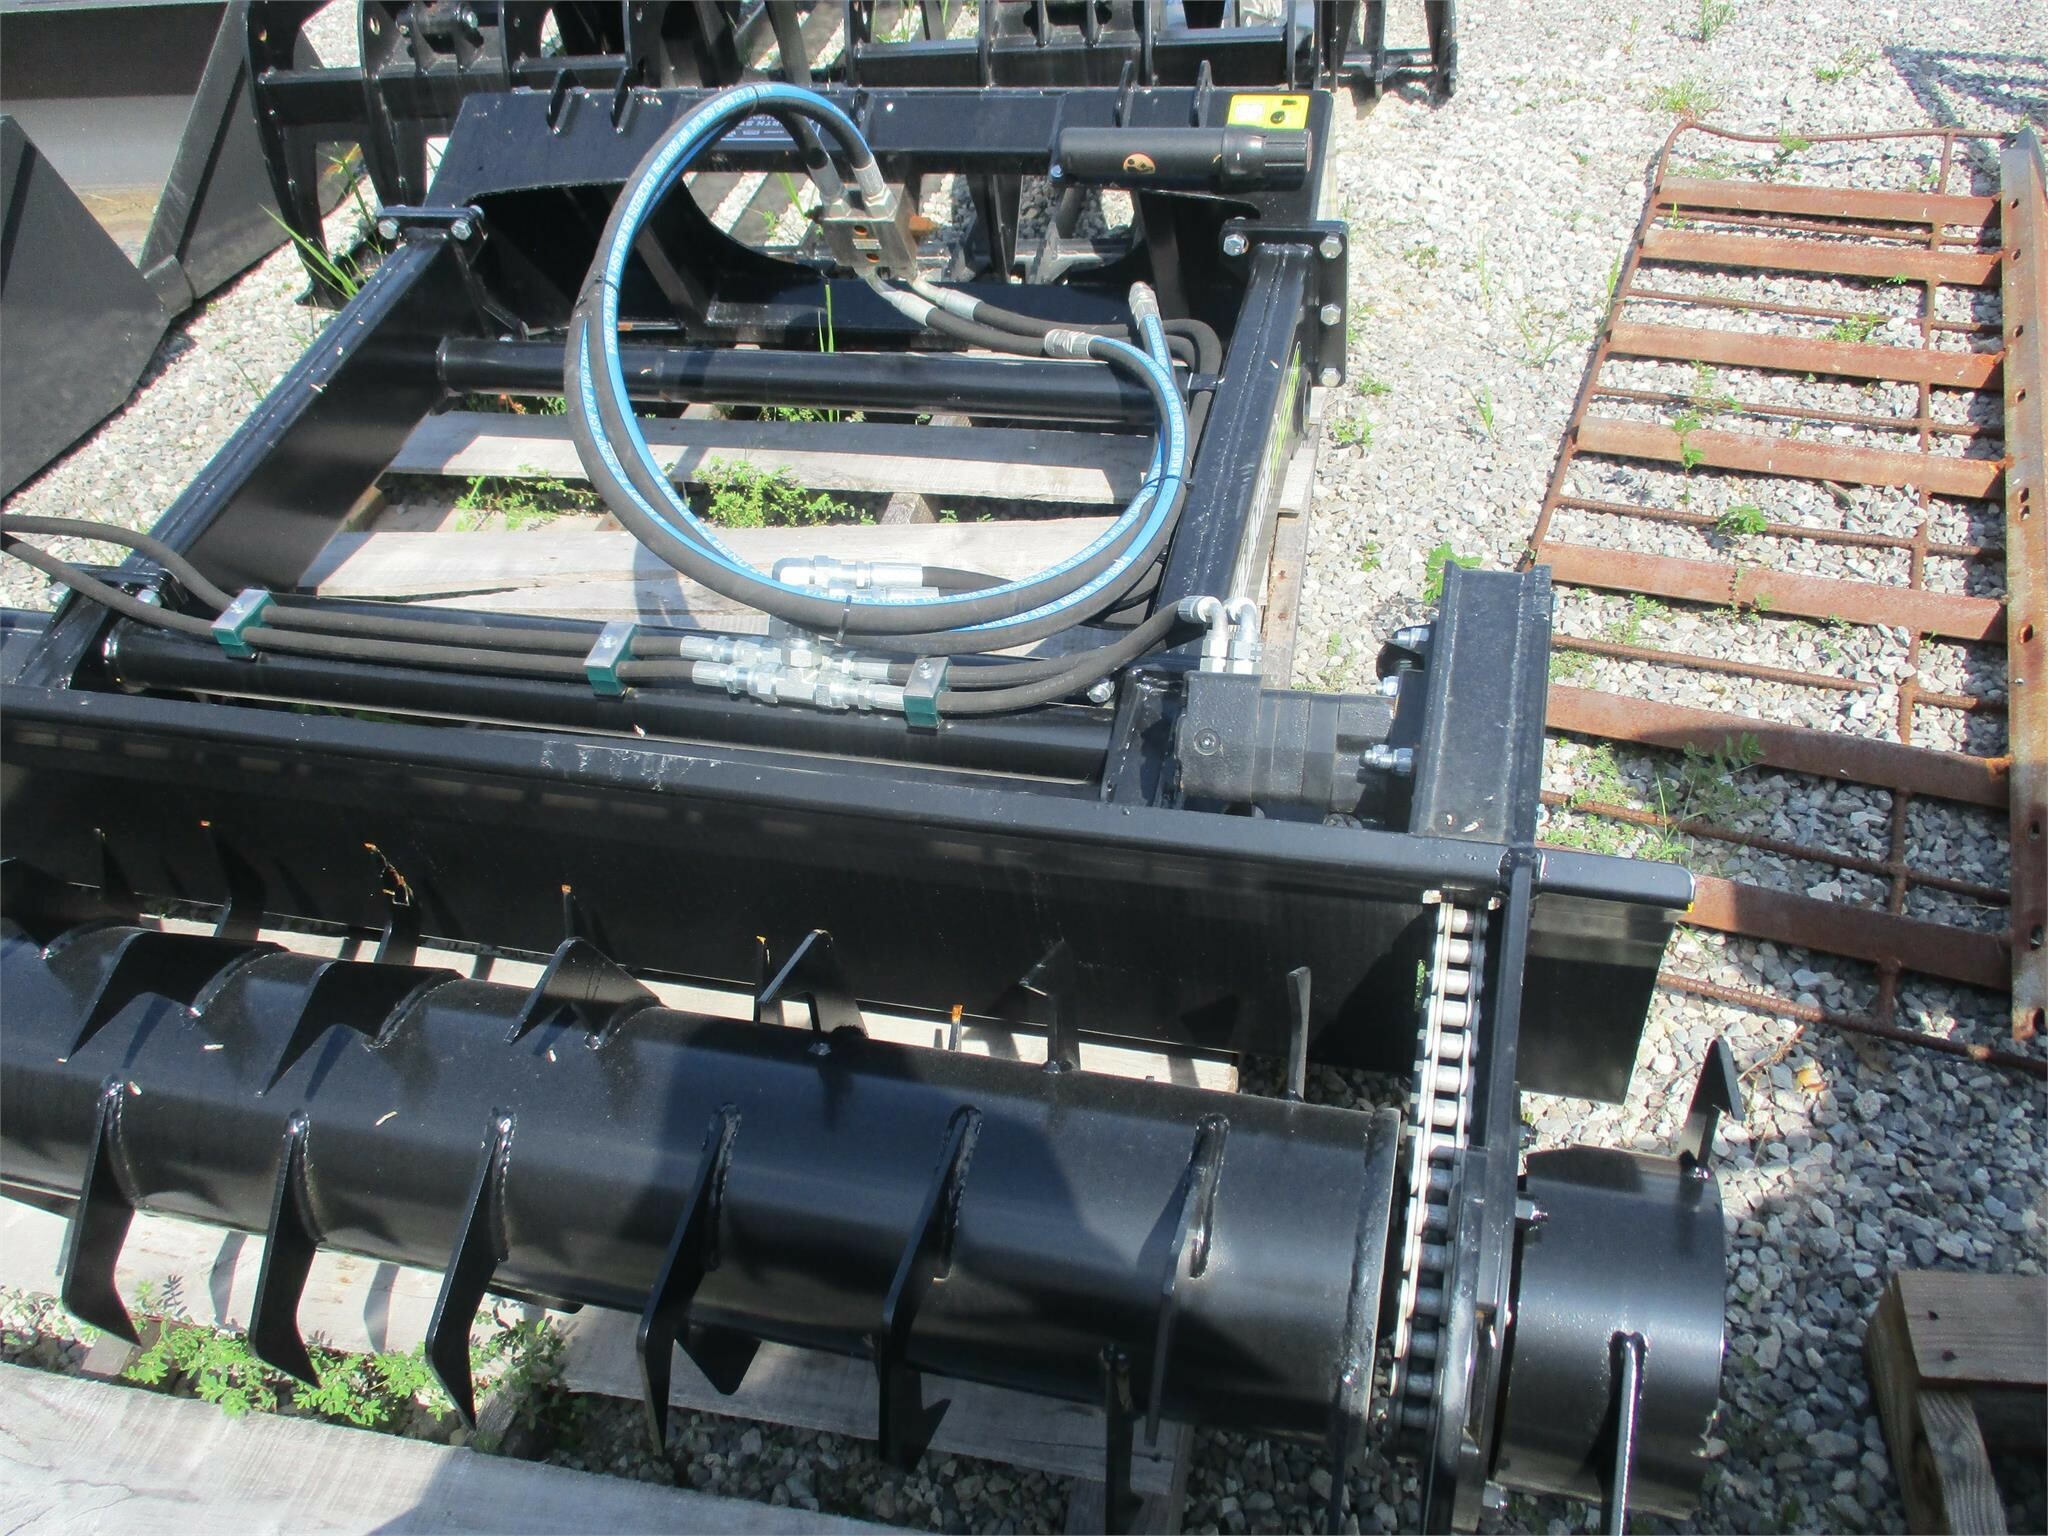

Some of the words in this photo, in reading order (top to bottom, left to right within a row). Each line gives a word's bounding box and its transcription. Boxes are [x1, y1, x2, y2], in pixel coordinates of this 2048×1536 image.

[712, 92, 736, 113] BEND
[674, 127, 692, 145] WP
[659, 137, 682, 162] 6000
[650, 155, 668, 174] PSI
[625, 171, 657, 218] EXCEEDS
[619, 214, 635, 233] EN
[593, 431, 618, 466] BEND
[660, 482, 691, 519] KURT
[711, 537, 749, 570] BEND
[1058, 582, 1096, 608] MSHA
